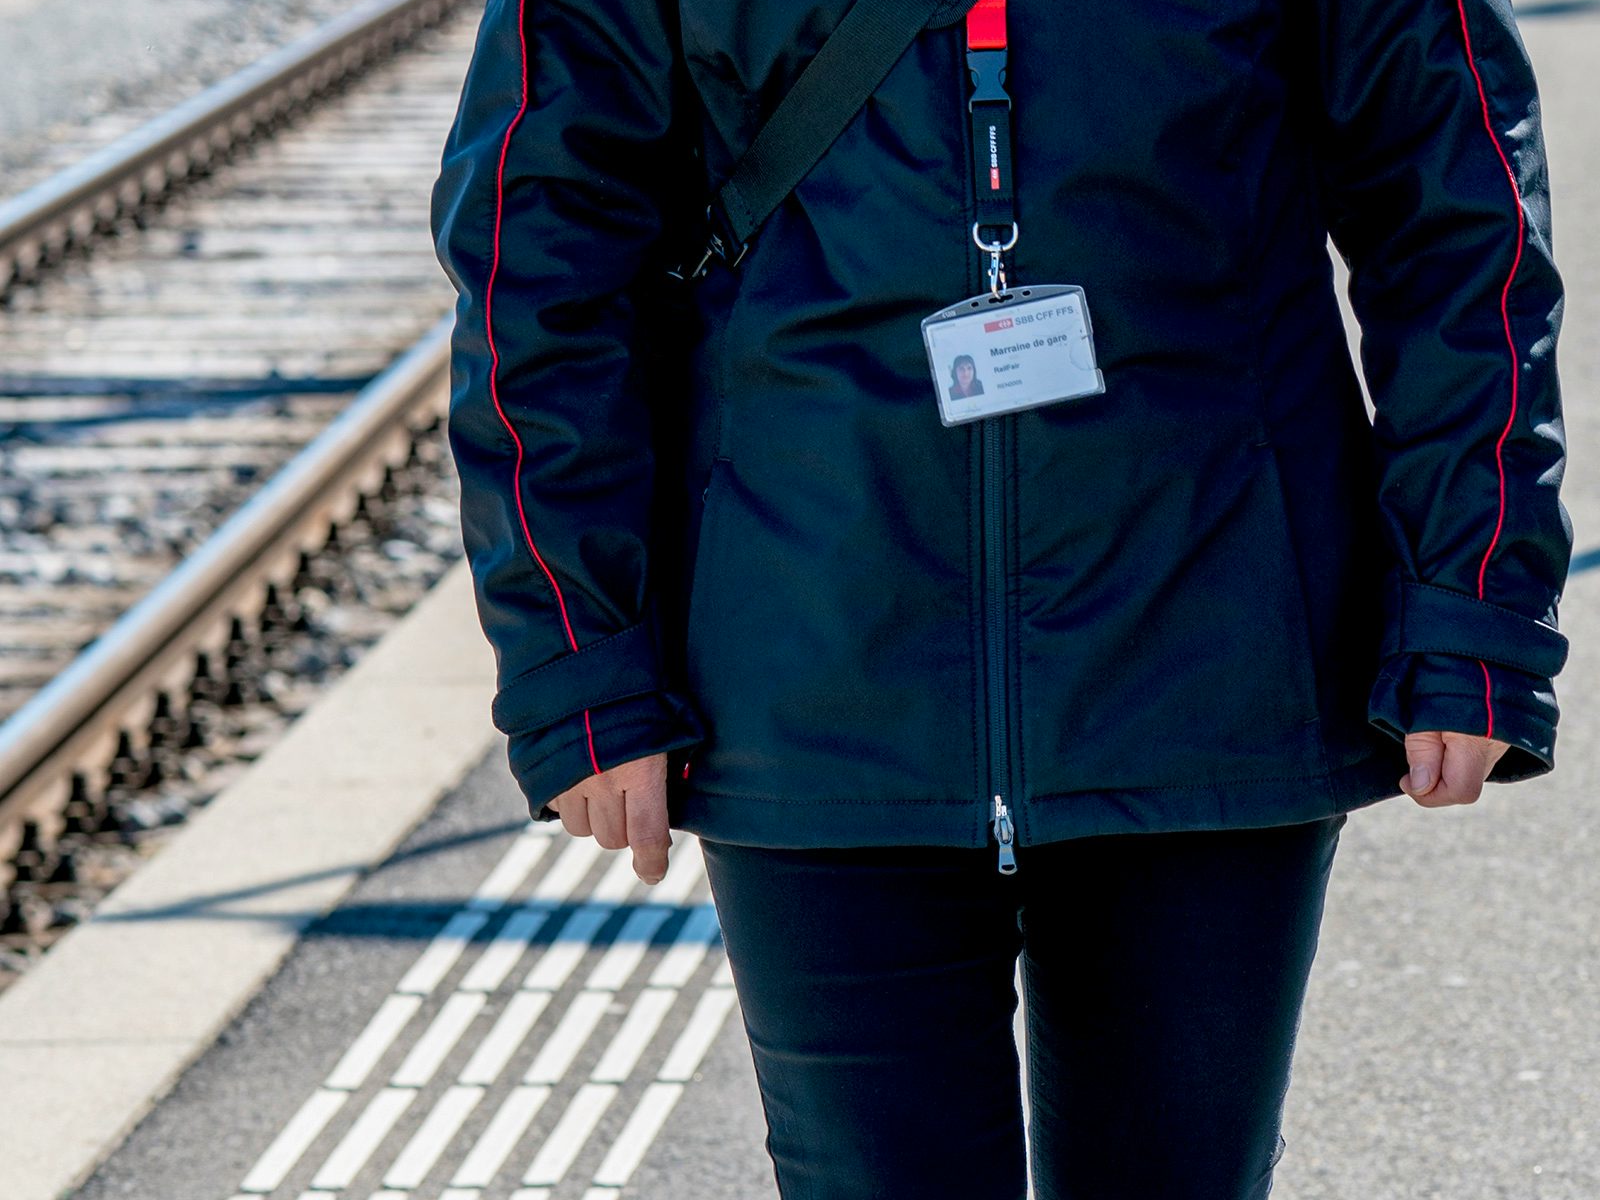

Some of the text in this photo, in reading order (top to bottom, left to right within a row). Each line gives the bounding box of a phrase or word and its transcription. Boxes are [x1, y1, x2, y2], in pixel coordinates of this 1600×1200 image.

[1015, 306, 1074, 326] SBB CFF FFS
[990, 334, 1068, 357] Marraine de gare
